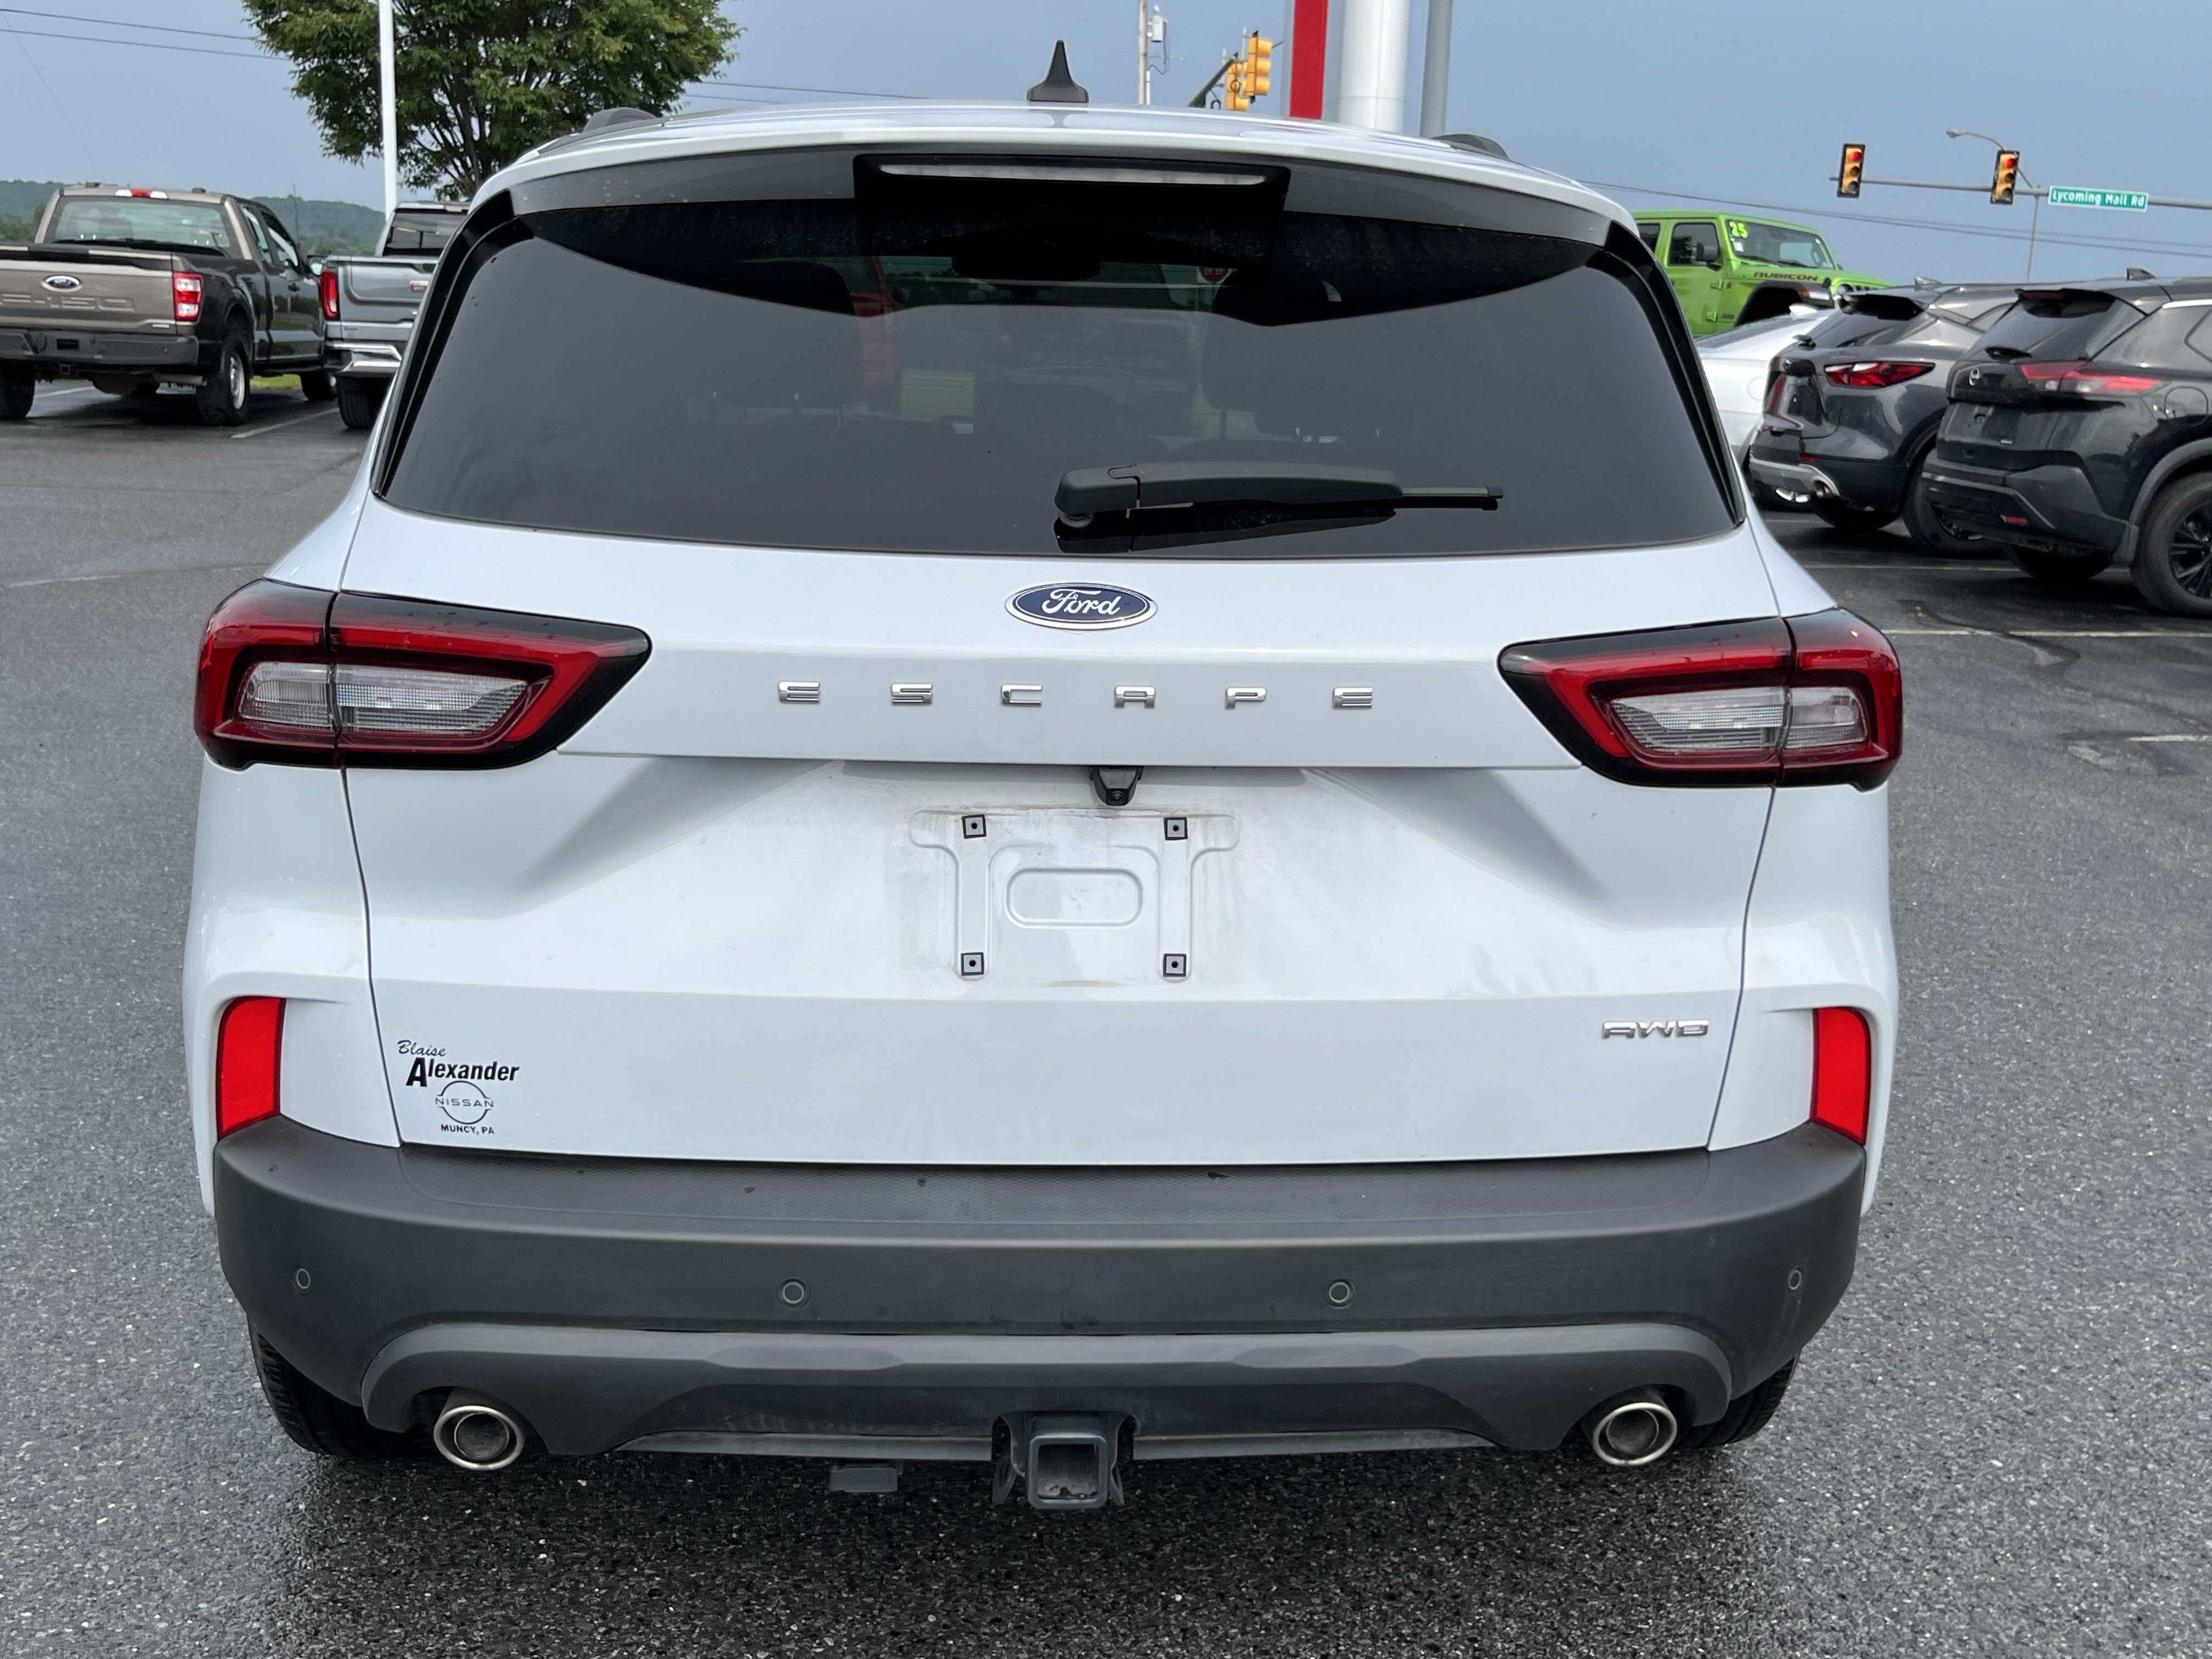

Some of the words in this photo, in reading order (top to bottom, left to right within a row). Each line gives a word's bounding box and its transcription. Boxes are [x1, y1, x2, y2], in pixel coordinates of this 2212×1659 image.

[2053, 190, 2102, 207] Lycoming
[2105, 193, 2128, 206] Mall
[2130, 195, 2145, 207] Rd
[1729, 221, 1748, 239] 25
[1753, 272, 1819, 281] RUBICON
[1041, 588, 1123, 615] Ford
[777, 680, 1373, 710] ESCAPE
[1601, 1019, 1710, 1039] AWD
[397, 1040, 447, 1057] Blaise
[405, 1057, 520, 1087] Alexander
[435, 1097, 494, 1108] NISSAN
[441, 1124, 479, 1135] MUNCY,
[481, 1126, 495, 1135] PA
